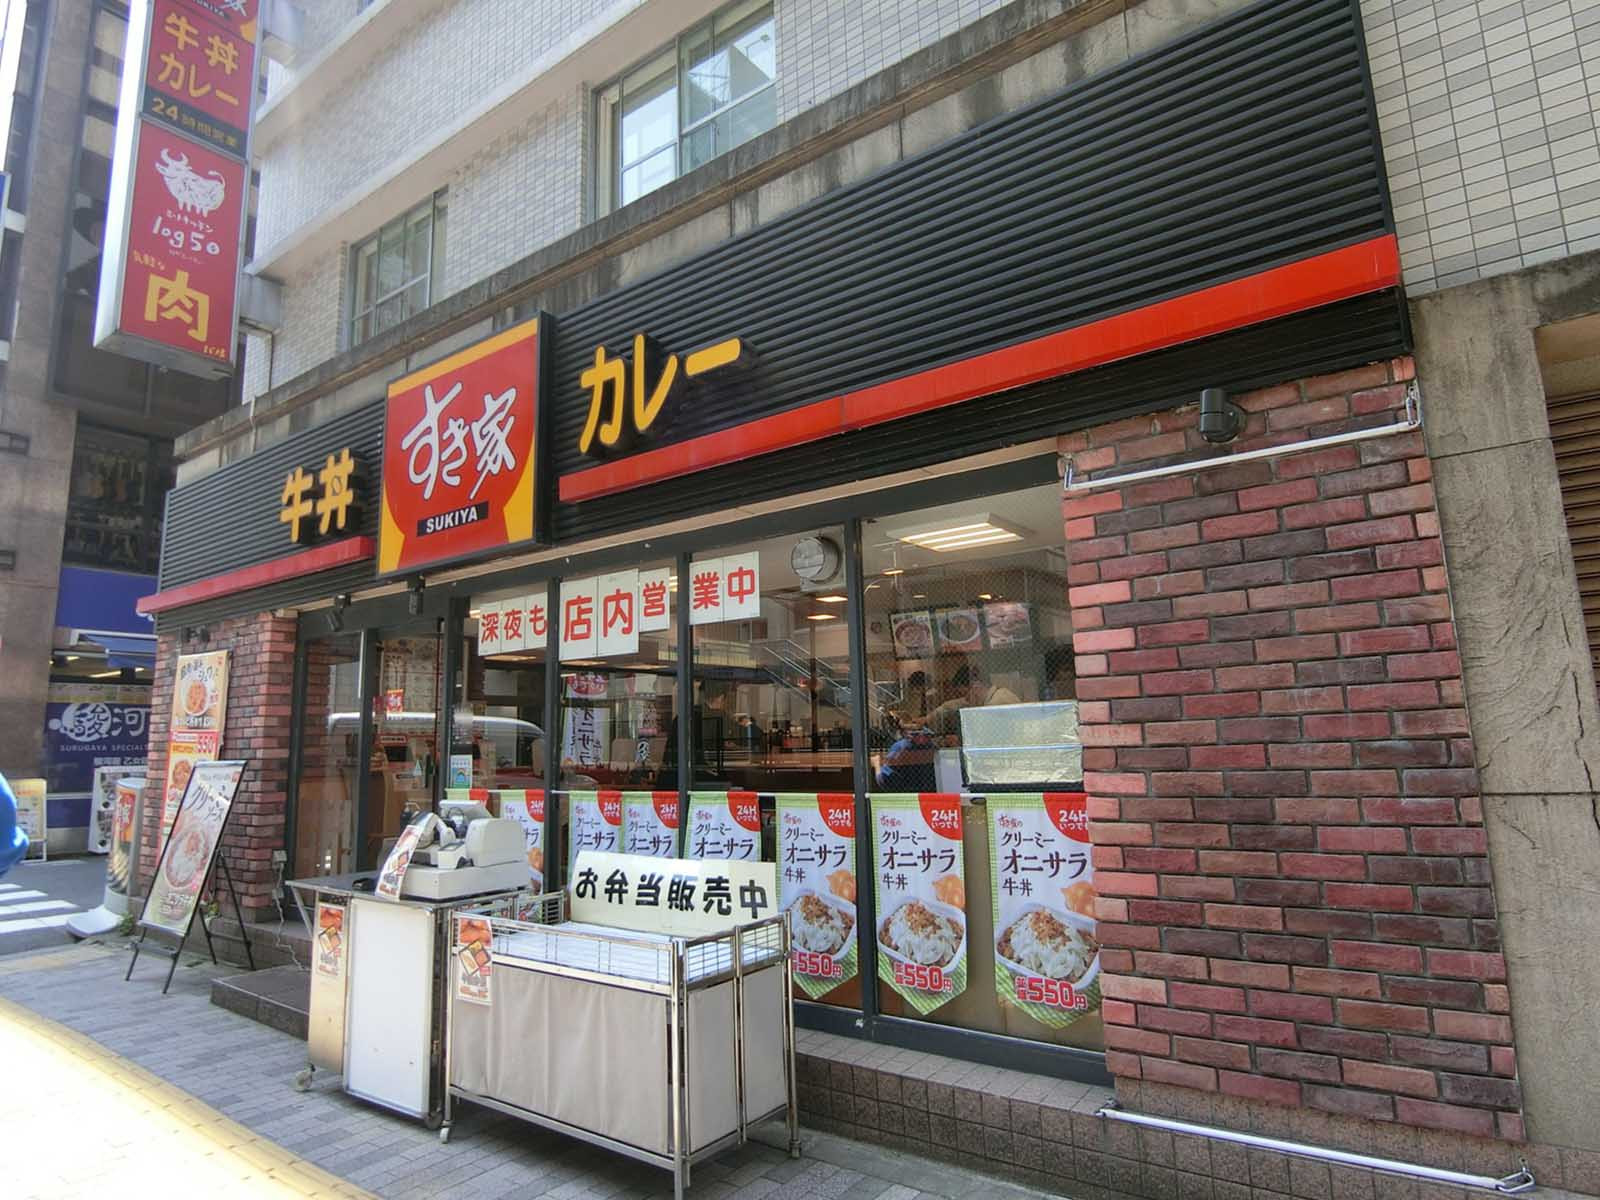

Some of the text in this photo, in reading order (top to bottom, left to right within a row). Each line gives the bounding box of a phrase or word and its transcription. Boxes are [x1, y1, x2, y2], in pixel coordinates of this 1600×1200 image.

[165, 12, 239, 75] 牛丼
[158, 52, 239, 107] カレー
[144, 269, 210, 342] 肉
[579, 333, 742, 454] カレー
[401, 381, 517, 501] すき家
[279, 447, 354, 544] 牛丼
[425, 504, 479, 534] SUKIYA
[480, 603, 549, 644] 深夜も
[736, 805, 757, 816] 24H
[828, 808, 851, 820] 24H
[931, 809, 958, 822] 24H
[1058, 809, 1089, 823] 24H
[695, 823, 733, 836] クリーミー
[785, 826, 825, 842] クリーミー
[881, 829, 928, 846] クリーミー
[931, 820, 959, 830] いつでも
[629, 834, 672, 855] オニサラ
[694, 837, 755, 860] オニサラ
[1001, 831, 1055, 848] クリーミー
[785, 842, 847, 868] オニサラ
[881, 846, 956, 873] オニサラ
[1001, 848, 1088, 879] オニサラ
[576, 867, 769, 919] お弁当販売中
